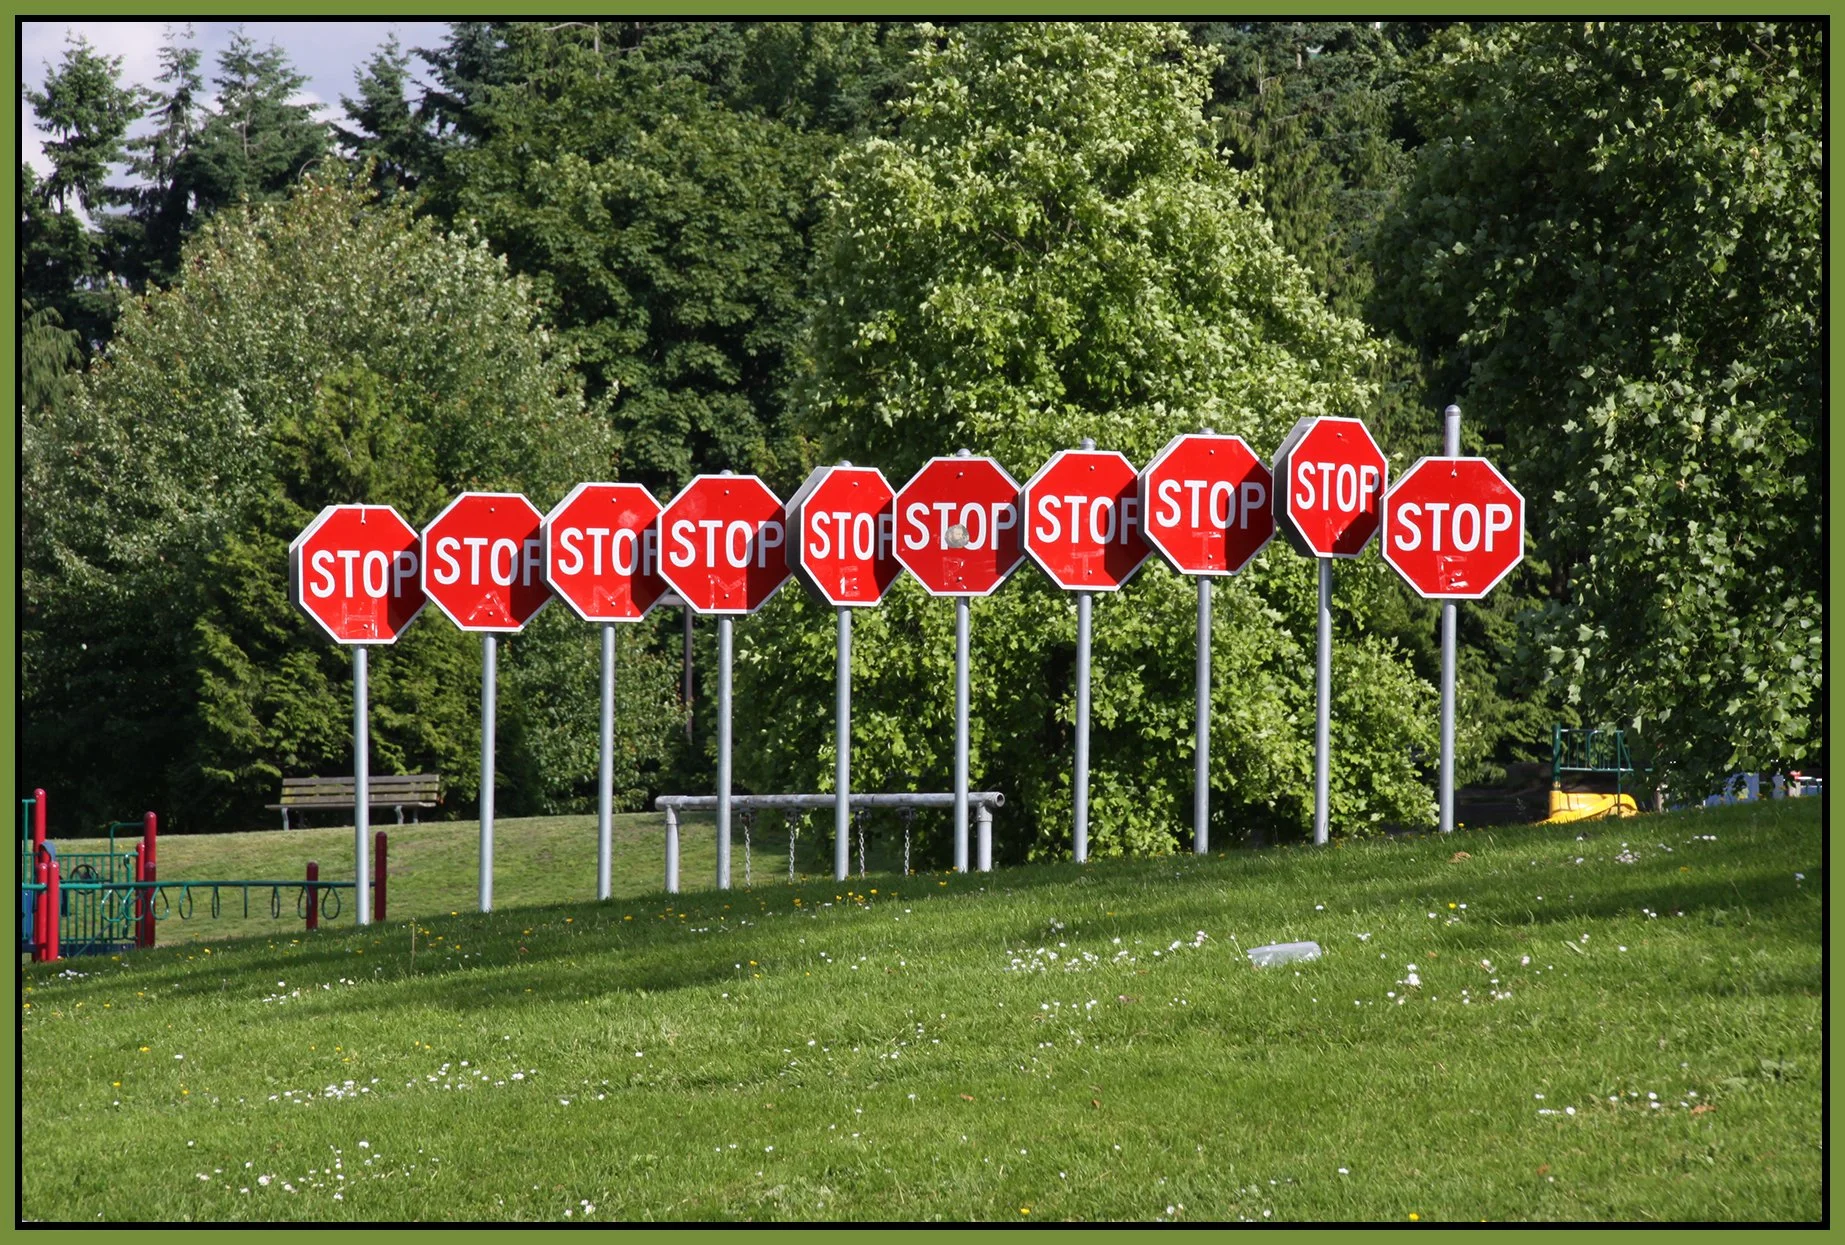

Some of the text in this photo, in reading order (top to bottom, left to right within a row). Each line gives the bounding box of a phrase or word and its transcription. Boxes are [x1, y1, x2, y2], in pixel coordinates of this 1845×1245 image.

[1155, 479, 1266, 529] STOP
[1296, 461, 1380, 512] STOP
[669, 519, 784, 568] STOP
[903, 502, 1018, 551] STOP
[1394, 502, 1513, 552] STOP
[310, 550, 418, 598] STOP
